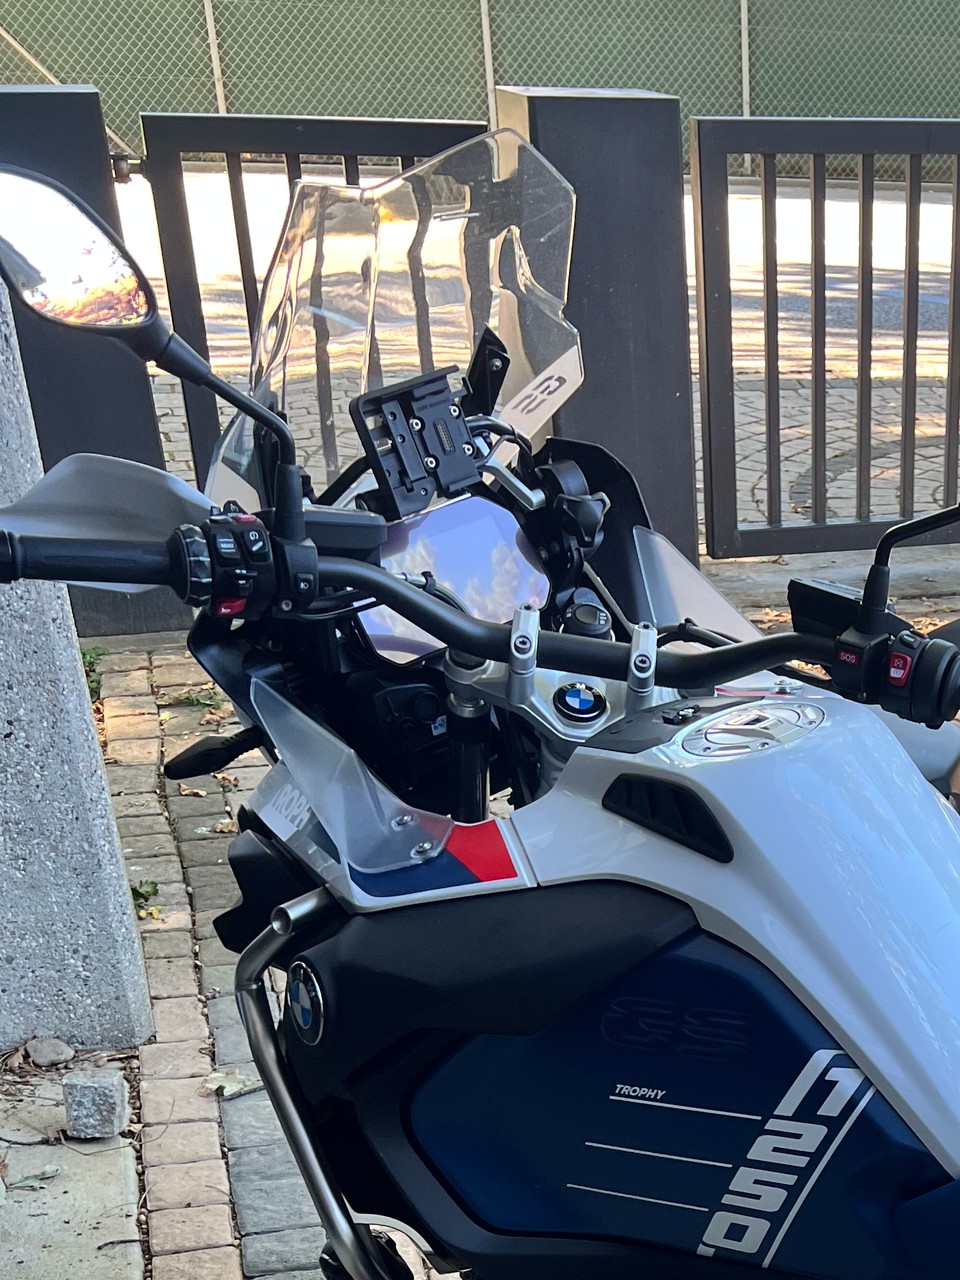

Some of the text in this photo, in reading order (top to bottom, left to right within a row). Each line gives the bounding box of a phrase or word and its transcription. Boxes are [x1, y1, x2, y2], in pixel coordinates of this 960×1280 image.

[840, 652, 856, 663] SOS
[601, 997, 752, 1062] GS
[614, 1084, 666, 1100] TROPHY
[702, 1067, 867, 1254] 1250
